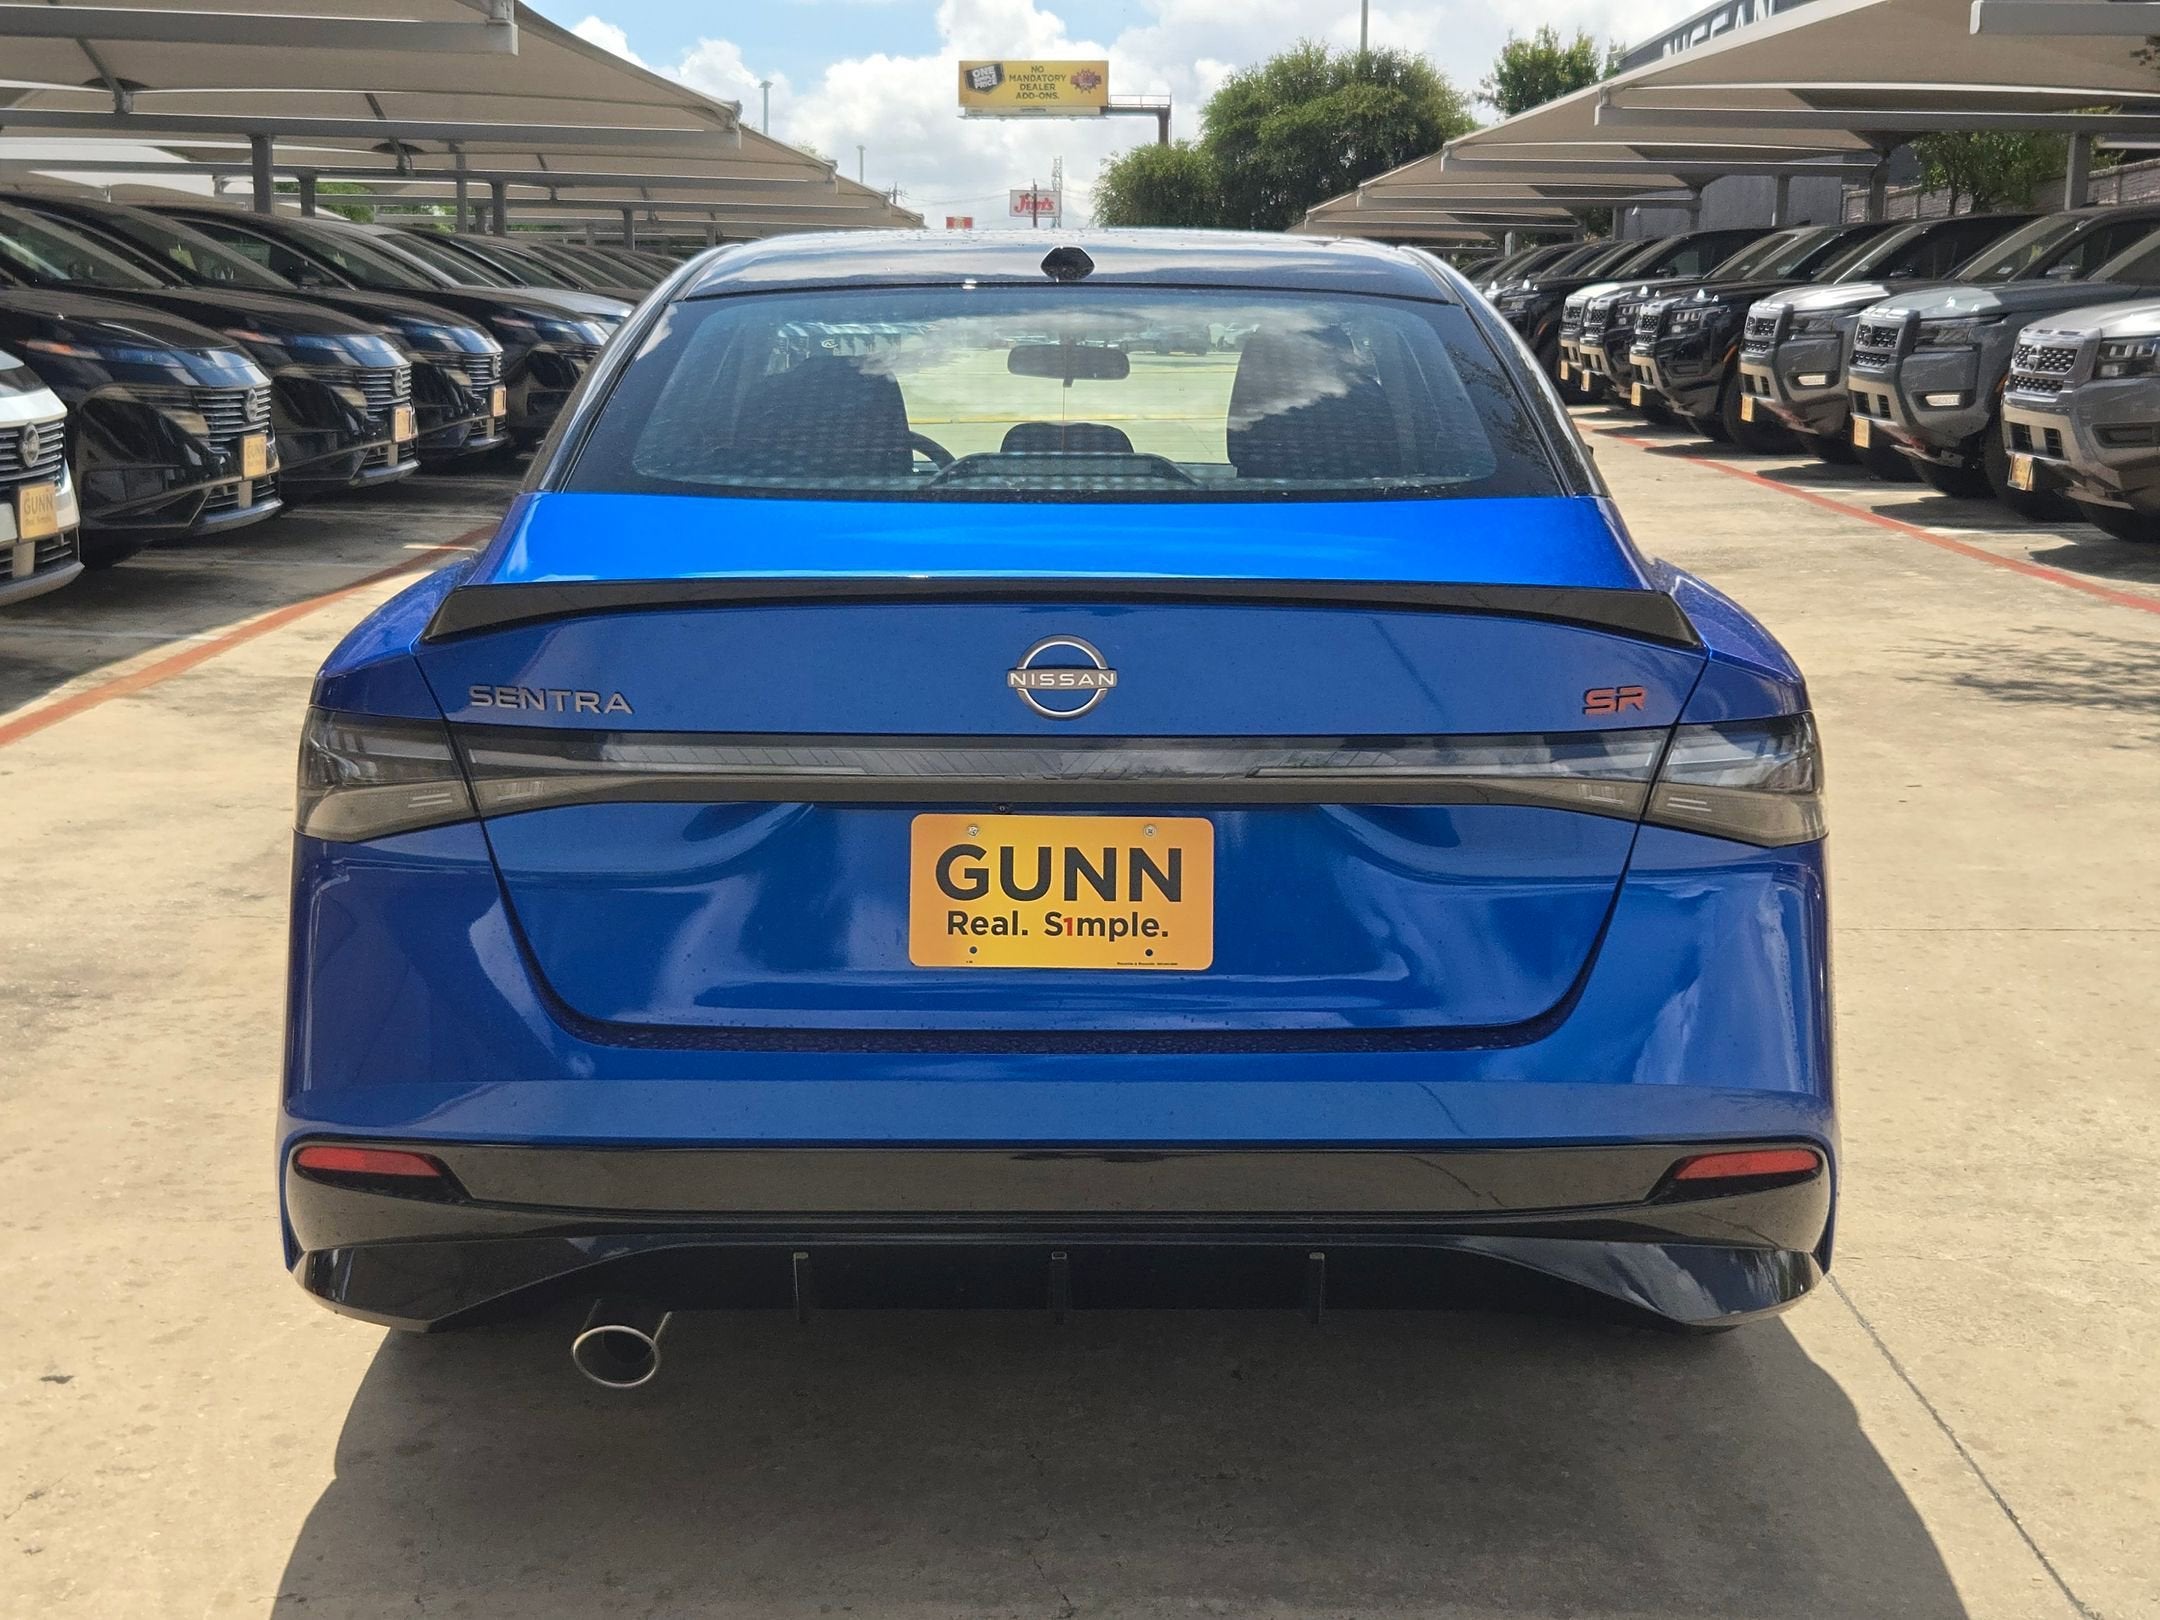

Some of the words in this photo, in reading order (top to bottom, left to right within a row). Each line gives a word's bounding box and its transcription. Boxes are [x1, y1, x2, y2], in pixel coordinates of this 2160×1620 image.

[972, 66, 995, 77] ONE
[1031, 65, 1045, 73] NO
[24, 493, 54, 515] GUNN
[1009, 672, 1114, 686] NISSAN
[468, 684, 634, 715] SENTRA
[1582, 684, 1645, 716] SR
[935, 843, 1182, 903] GUNN
[947, 910, 1028, 937] Real.
